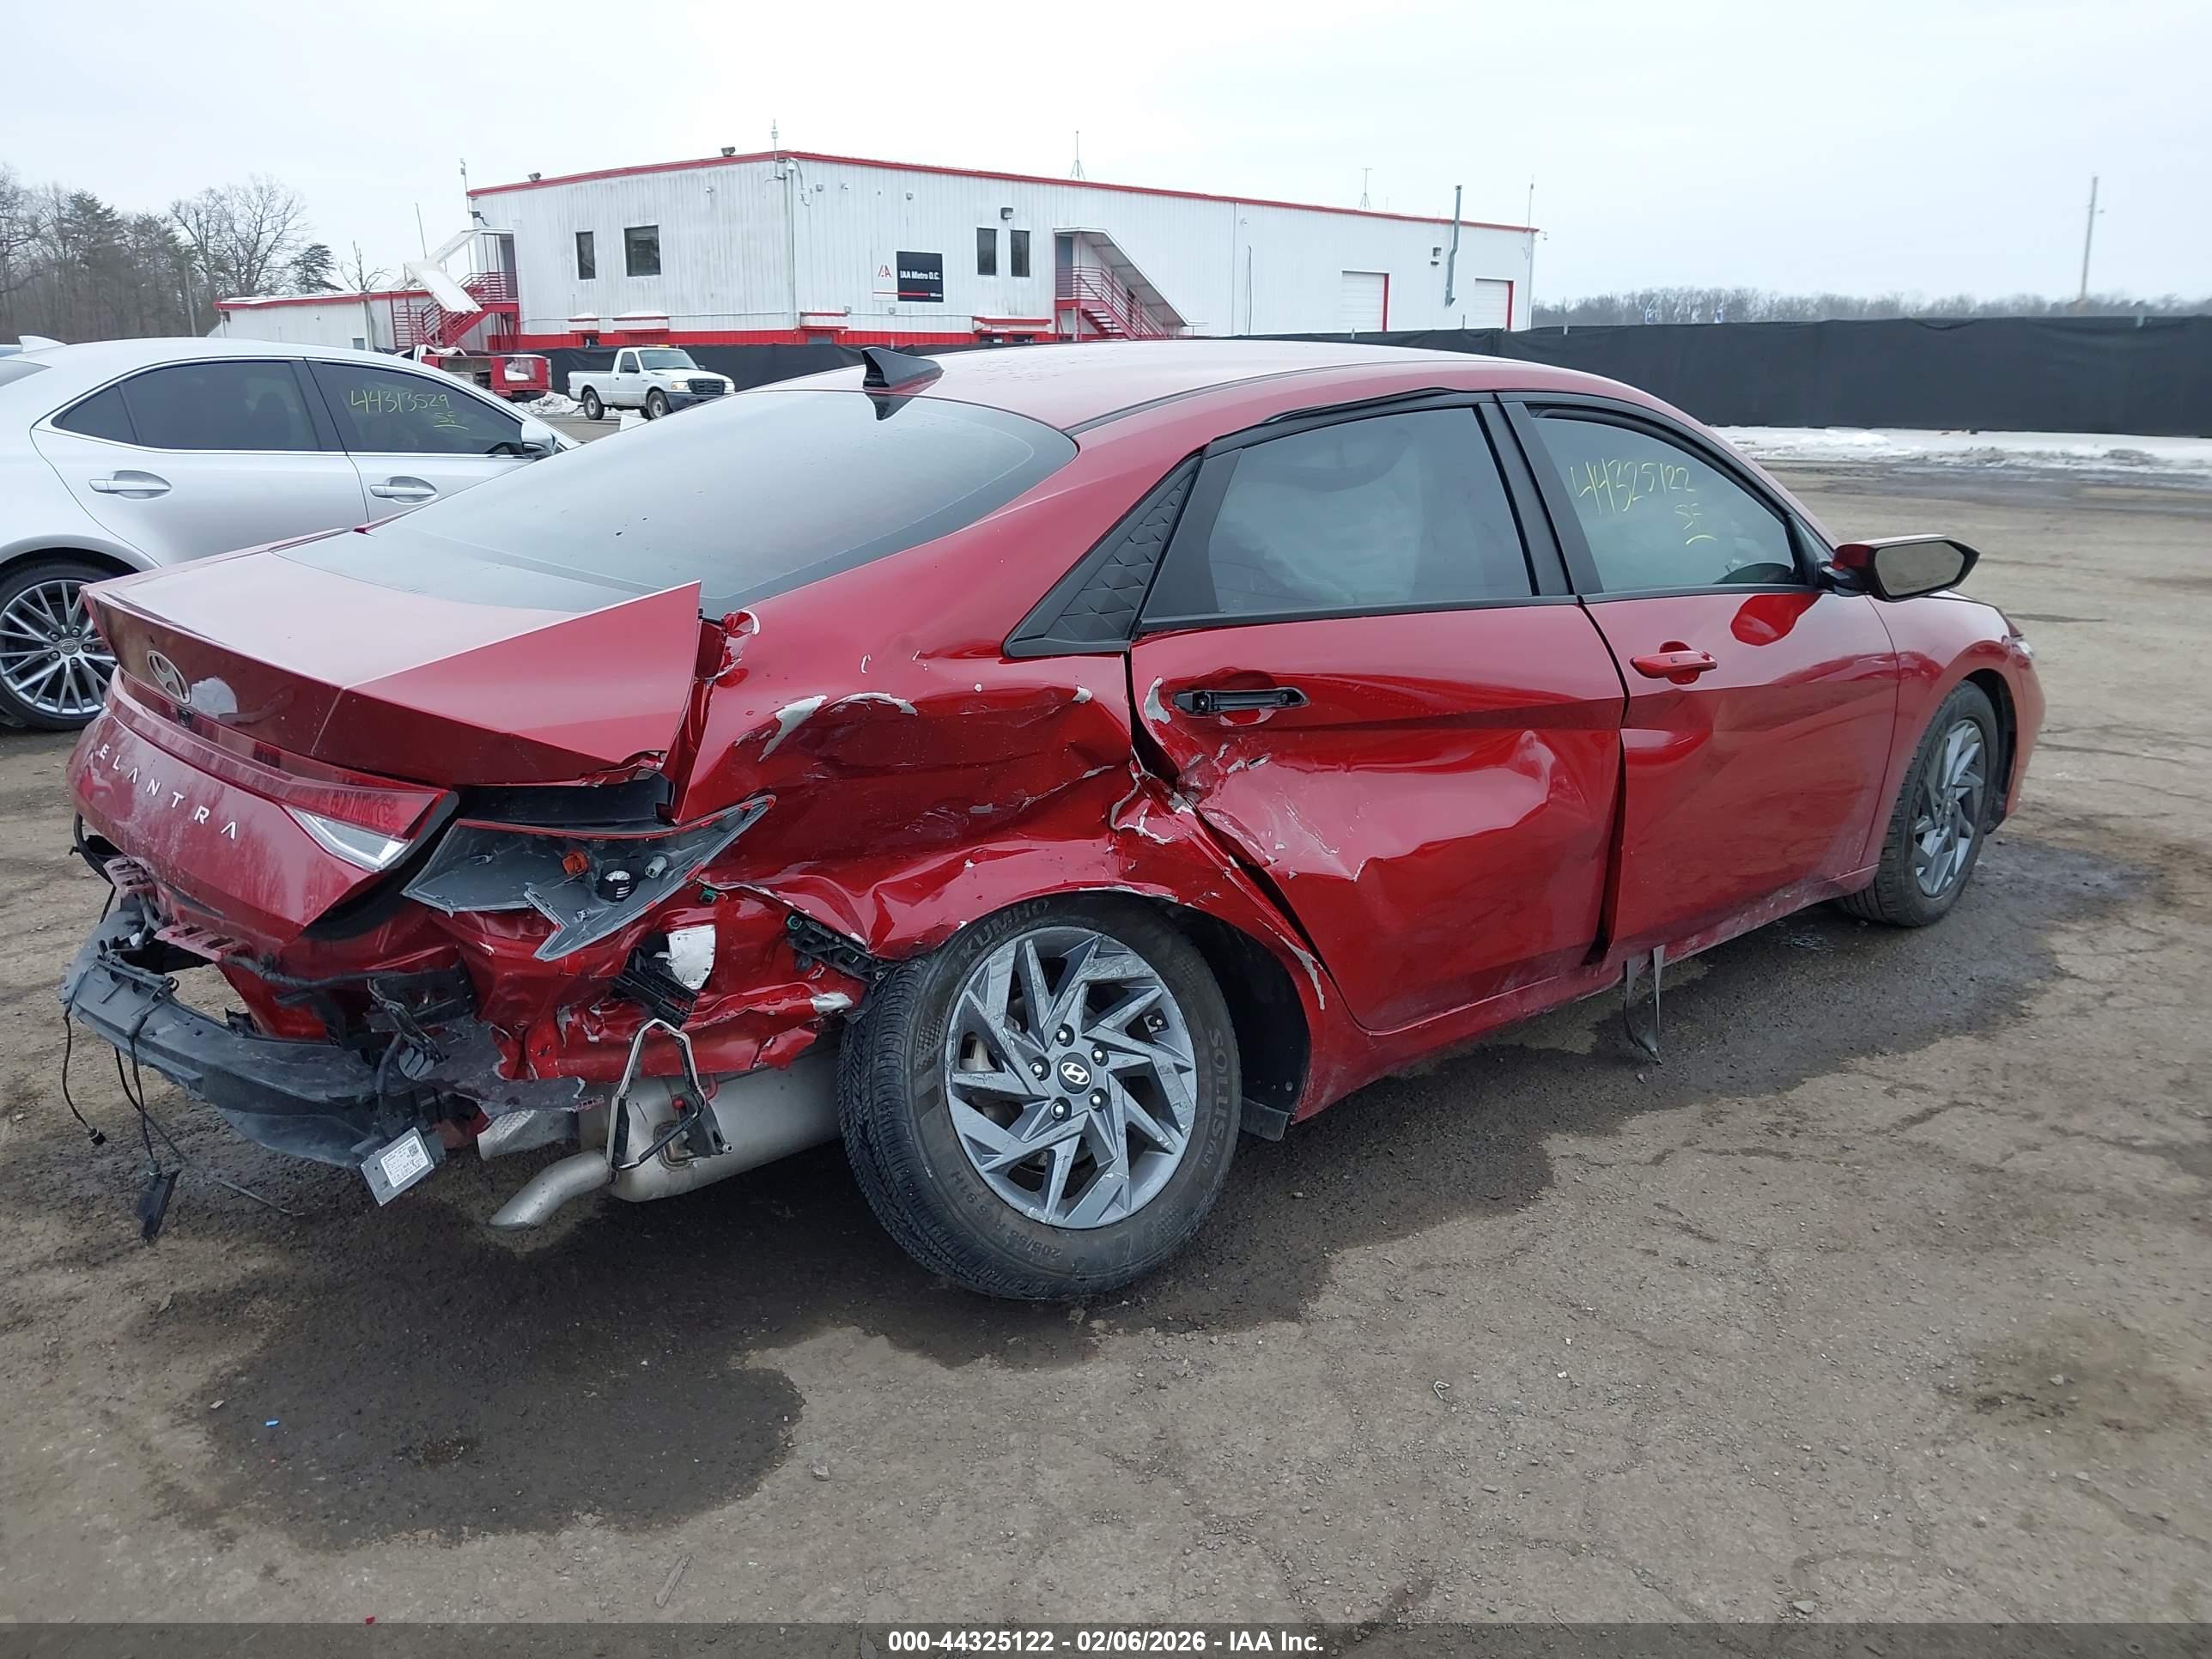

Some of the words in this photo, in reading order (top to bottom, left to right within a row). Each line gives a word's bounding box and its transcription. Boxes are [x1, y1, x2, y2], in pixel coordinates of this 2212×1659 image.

[899, 270, 911, 279] IAA
[911, 270, 928, 280] Metro
[350, 389, 451, 413] 44313529
[1570, 458, 1697, 515] 44325122
[99, 743, 237, 840] ELANTRA
[959, 898, 1050, 963] KUMHO
[1208, 1029, 1230, 1139] SOLUS
